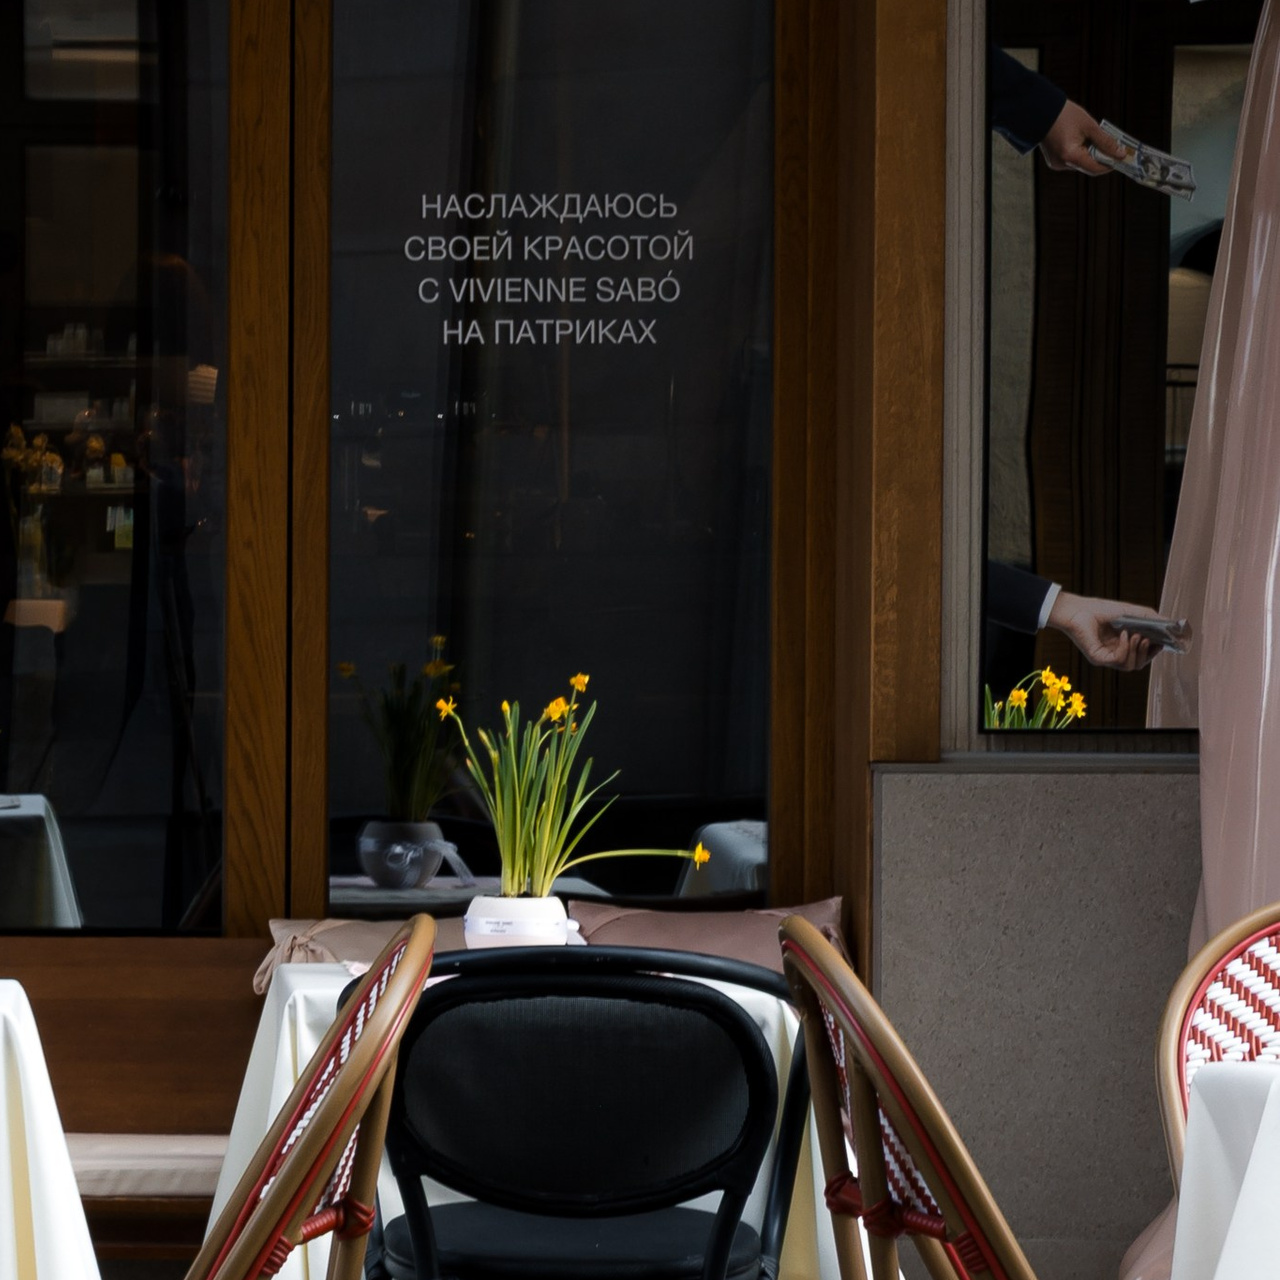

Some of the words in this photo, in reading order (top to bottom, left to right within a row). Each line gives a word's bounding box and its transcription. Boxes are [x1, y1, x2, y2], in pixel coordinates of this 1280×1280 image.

[421, 193, 678, 224] НАСЛАЖДАЮСЬ
[404, 229, 513, 261] СВОЕЙ
[524, 229, 694, 261] КРАСОТОЙ
[449, 277, 587, 303] VIVIENNE
[596, 269, 681, 304] SABÓ
[443, 319, 485, 345] НА
[495, 319, 657, 345] ПАТРИКАХ
